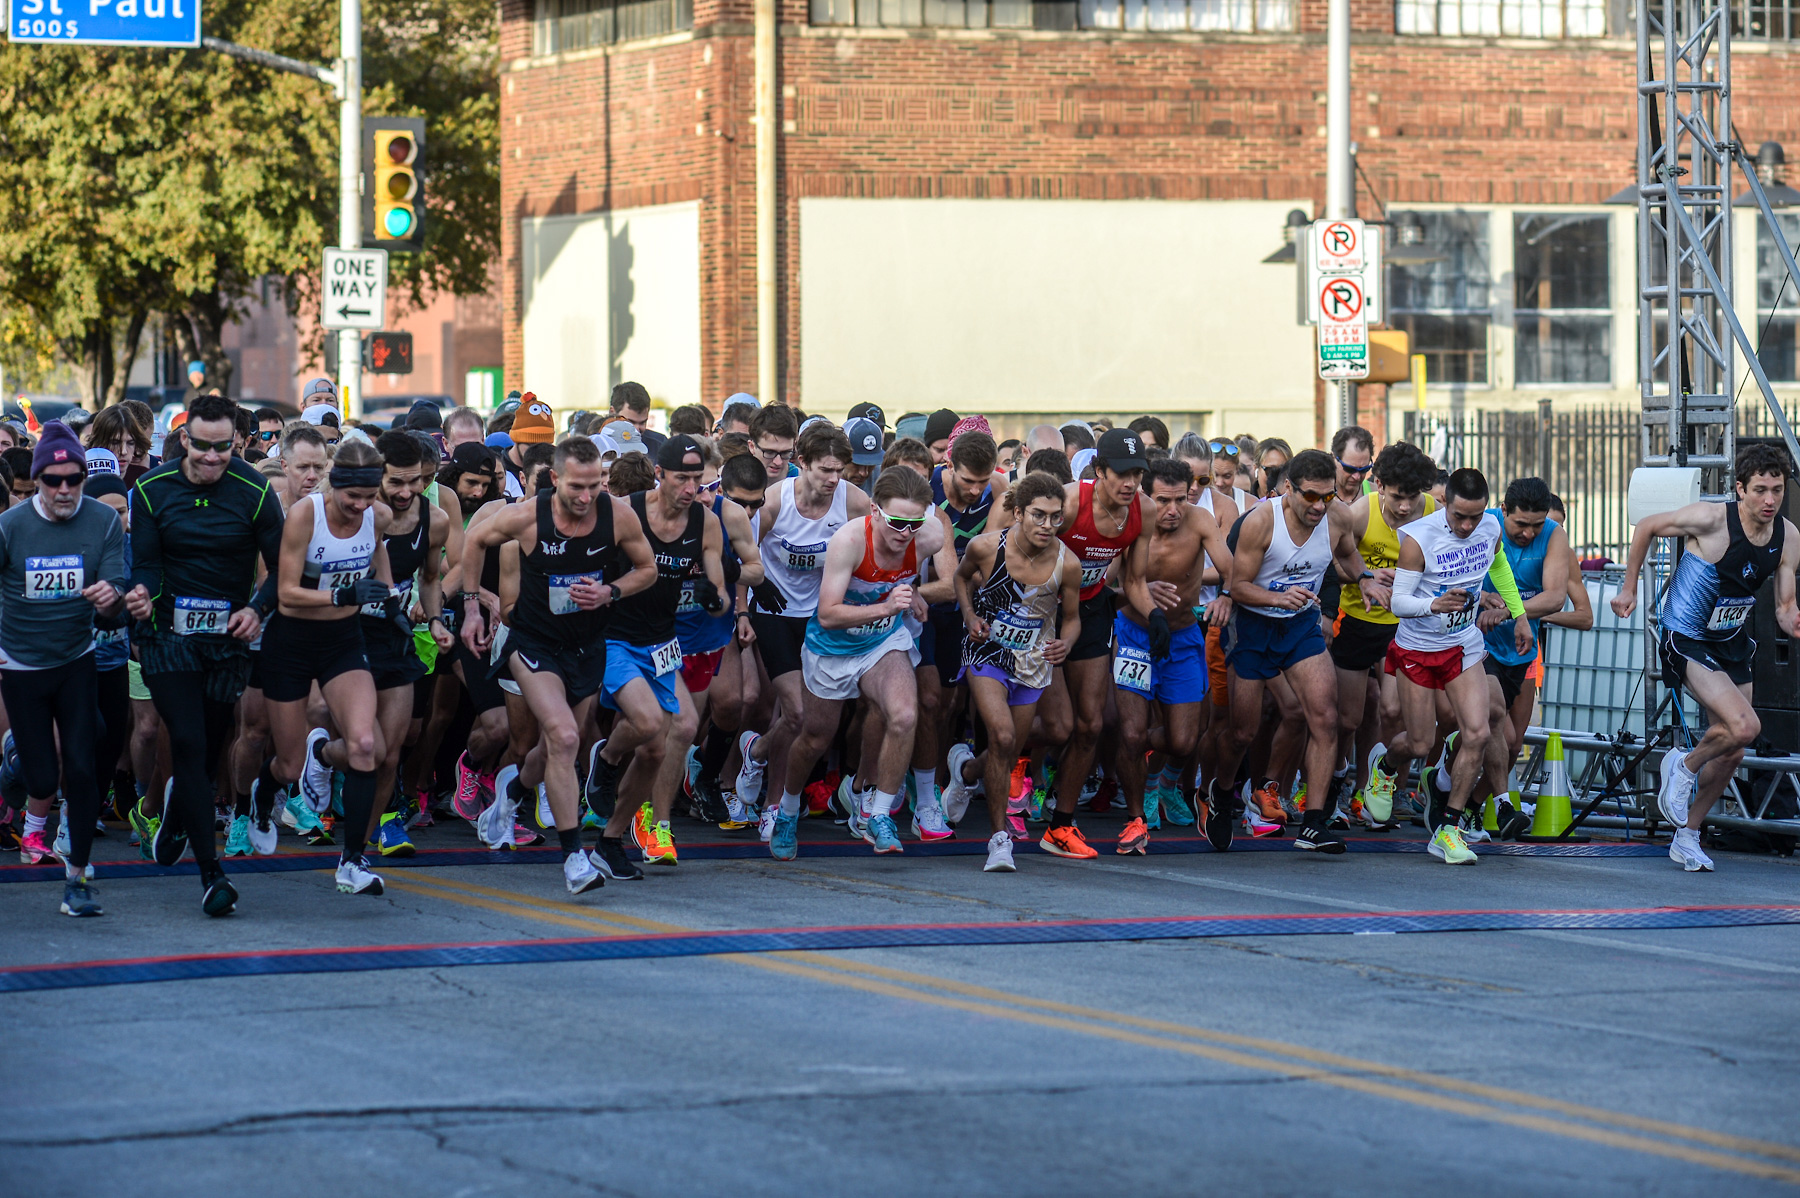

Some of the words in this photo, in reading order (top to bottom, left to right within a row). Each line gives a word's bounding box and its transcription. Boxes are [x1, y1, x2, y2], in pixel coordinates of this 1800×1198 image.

[90, 0, 184, 18] Paul
[334, 258, 375, 276] ONE
[331, 280, 377, 297] WAY
[352, 543, 371, 553] OAC
[1436, 549, 1464, 565] RAMON'S
[1465, 540, 1489, 558] PAINTING
[654, 551, 692, 570] ringer
[789, 553, 816, 567] 868
[1449, 559, 1467, 569] WOOD
[1468, 553, 1487, 564] REPAIR
[34, 571, 76, 590] 2216
[187, 612, 216, 629] 678
[1717, 606, 1746, 622] 1428
[996, 624, 1034, 643] 3169
[658, 641, 681, 668] 3746
[1119, 660, 1147, 680] 737
